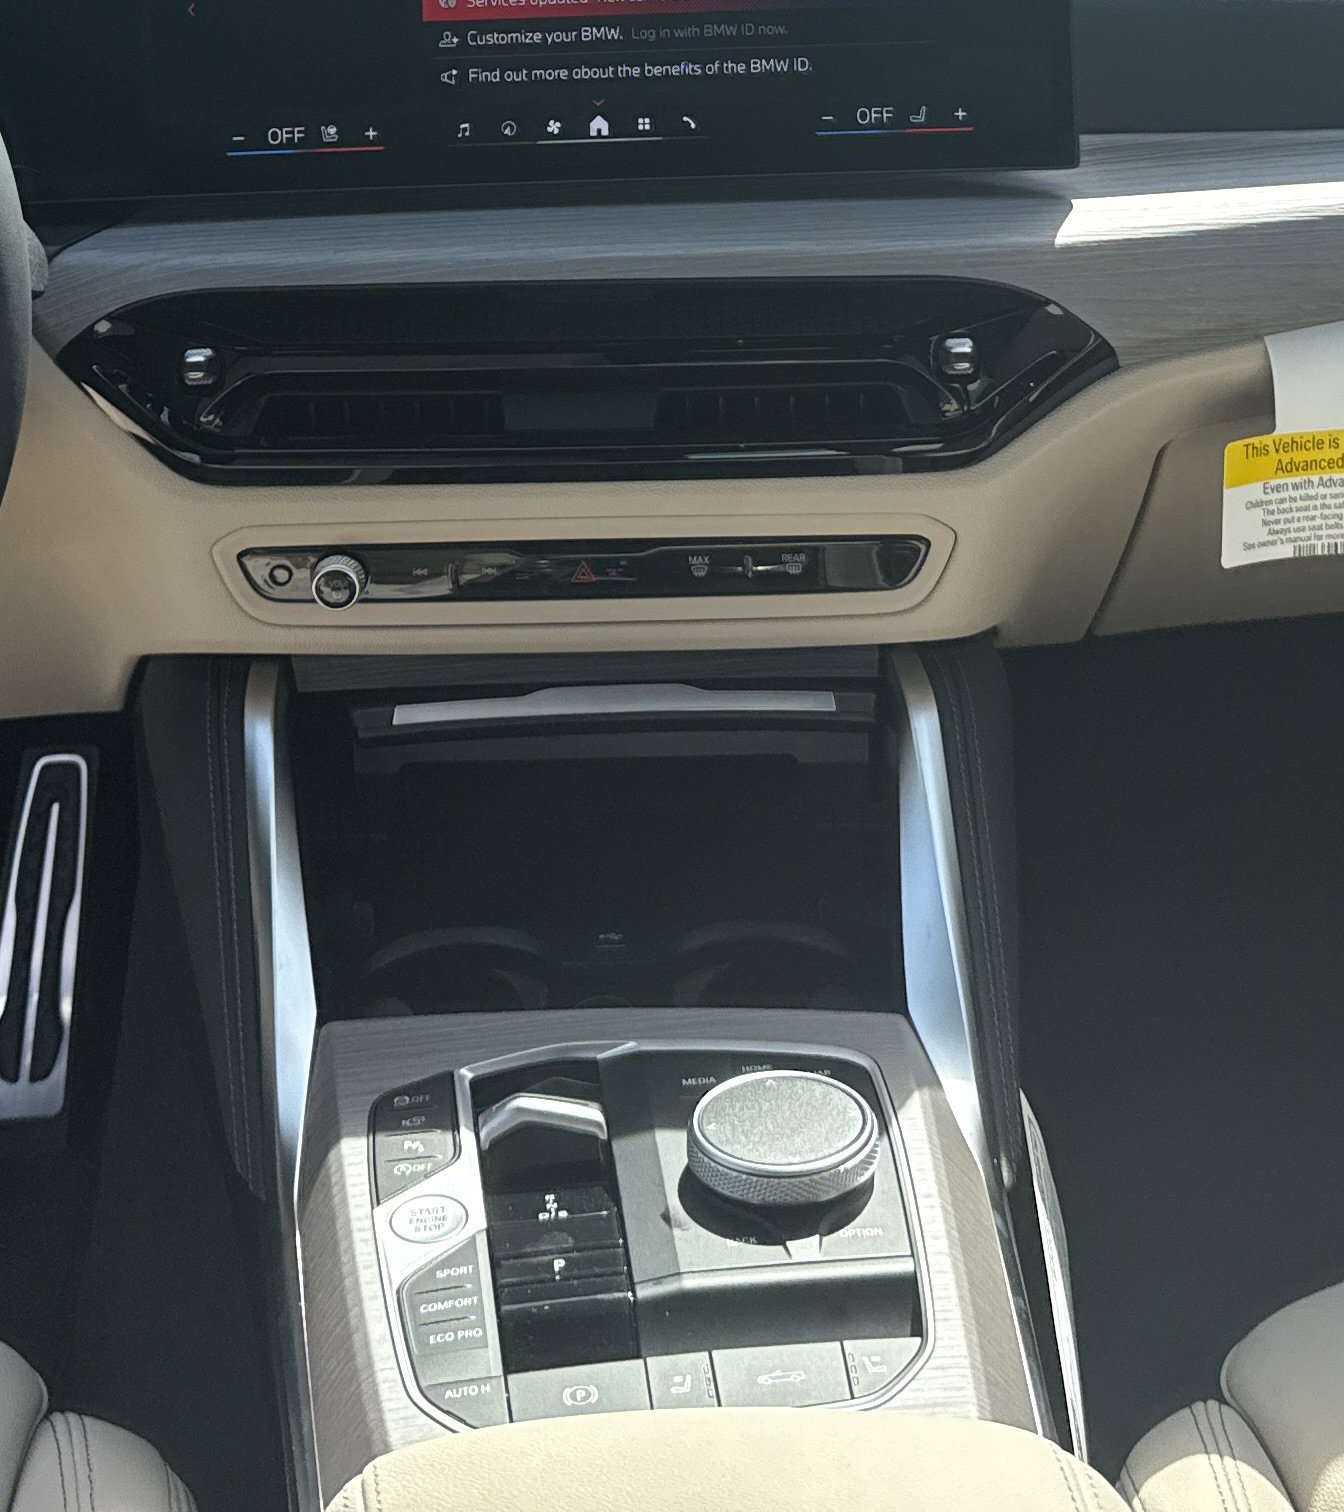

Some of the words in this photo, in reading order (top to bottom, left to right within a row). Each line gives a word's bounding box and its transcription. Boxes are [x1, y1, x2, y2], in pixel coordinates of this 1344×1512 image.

[467, 29, 542, 46] Customize
[545, 31, 578, 46] your
[581, 26, 624, 41] BMW.
[631, 27, 656, 41] Log
[659, 26, 671, 39] in
[674, 25, 701, 38] with
[703, 23, 738, 37] BMW
[740, 23, 755, 37] ID
[757, 24, 788, 35] now.
[468, 68, 500, 83] Find
[504, 70, 528, 82] out
[531, 68, 569, 81] more
[572, 65, 614, 80] about
[617, 64, 641, 78] the
[644, 61, 702, 77] benefits
[705, 61, 721, 75] of
[723, 60, 747, 75] the
[750, 58, 790, 73] BMW
[793, 57, 813, 72] ID.
[856, 106, 894, 125] OFF
[267, 126, 305, 145] OFF
[1242, 442, 1270, 460] This
[1272, 434, 1325, 454] Vehicle
[1328, 432, 1340, 449] is
[1274, 452, 1344, 475] Advanced
[1262, 481, 1289, 495] Even
[1291, 477, 1315, 491] with
[1245, 498, 1274, 510] Children
[1274, 496, 1287, 505] can
[1288, 494, 1298, 503] be
[1299, 492, 1319, 502] killed
[1320, 492, 1328, 500] or
[1262, 507, 1276, 517] The
[1276, 505, 1294, 515] back
[1295, 503, 1311, 512] seat
[1311, 503, 1319, 512] is
[1319, 501, 1333, 511] the
[1262, 517, 1281, 528] Never
[1283, 515, 1296, 525] put
[1302, 511, 1344, 522] rear-facing
[1267, 526, 1292, 537] Always
[1293, 525, 1306, 534] use
[1308, 522, 1324, 531] seat
[1324, 521, 1344, 531] belts
[1285, 533, 1312, 544] manual
[1313, 532, 1323, 541] for
[1325, 531, 1344, 540] more
[688, 555, 710, 565] MAX
[781, 553, 806, 563] REAR
[681, 1076, 718, 1087] MEDIA
[408, 1214, 448, 1225] ENGINE
[410, 1205, 446, 1217] START
[414, 1222, 445, 1233] STOP
[838, 1226, 884, 1239] OPTION
[435, 1264, 474, 1279] SPORT
[553, 1258, 566, 1272] P
[419, 1295, 479, 1314] COMFORT
[429, 1331, 455, 1345] ECO
[457, 1327, 483, 1340] PRO
[444, 1384, 479, 1400] AUTO
[481, 1383, 491, 1394] H
